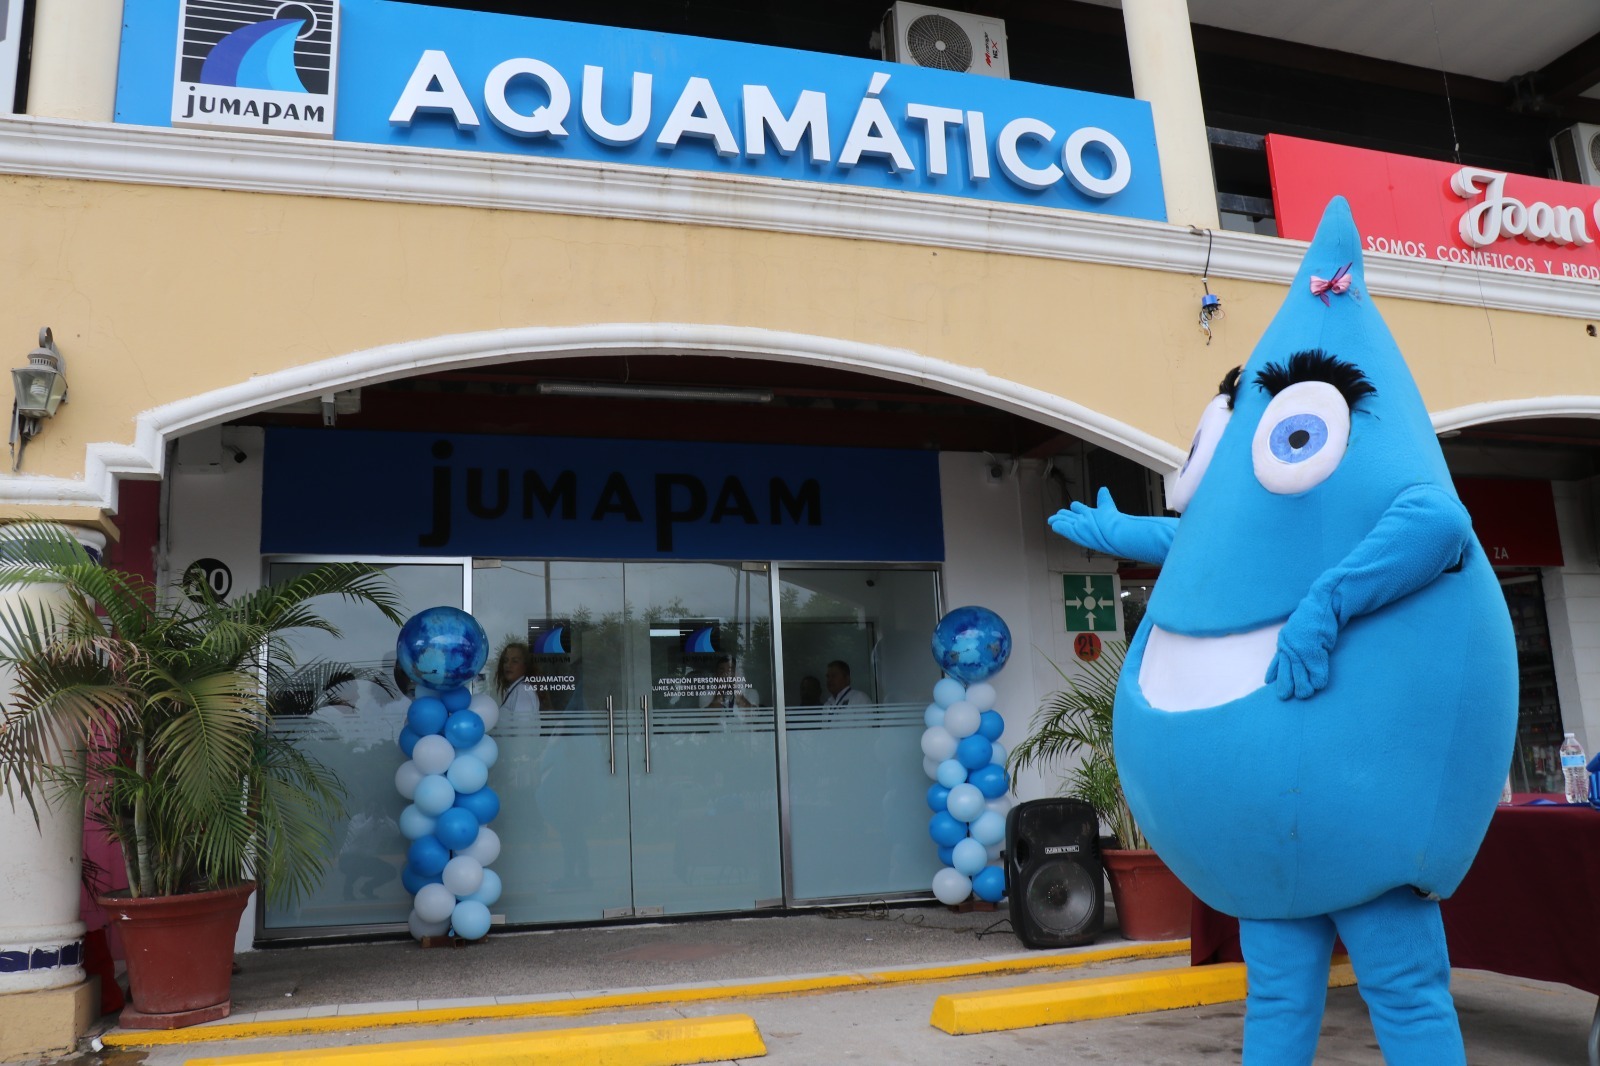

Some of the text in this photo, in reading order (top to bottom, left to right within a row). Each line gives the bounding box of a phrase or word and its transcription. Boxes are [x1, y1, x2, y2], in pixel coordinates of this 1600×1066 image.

[388, 49, 1132, 199] AQUAMÁTICO
[1450, 167, 1594, 248] Joan
[1367, 235, 1427, 259] SOMOS
[1436, 245, 1536, 273] COSMETICOS
[1543, 259, 1553, 275] Y
[1493, 546, 1509, 560] ZA
[1078, 634, 1095, 656] 21
